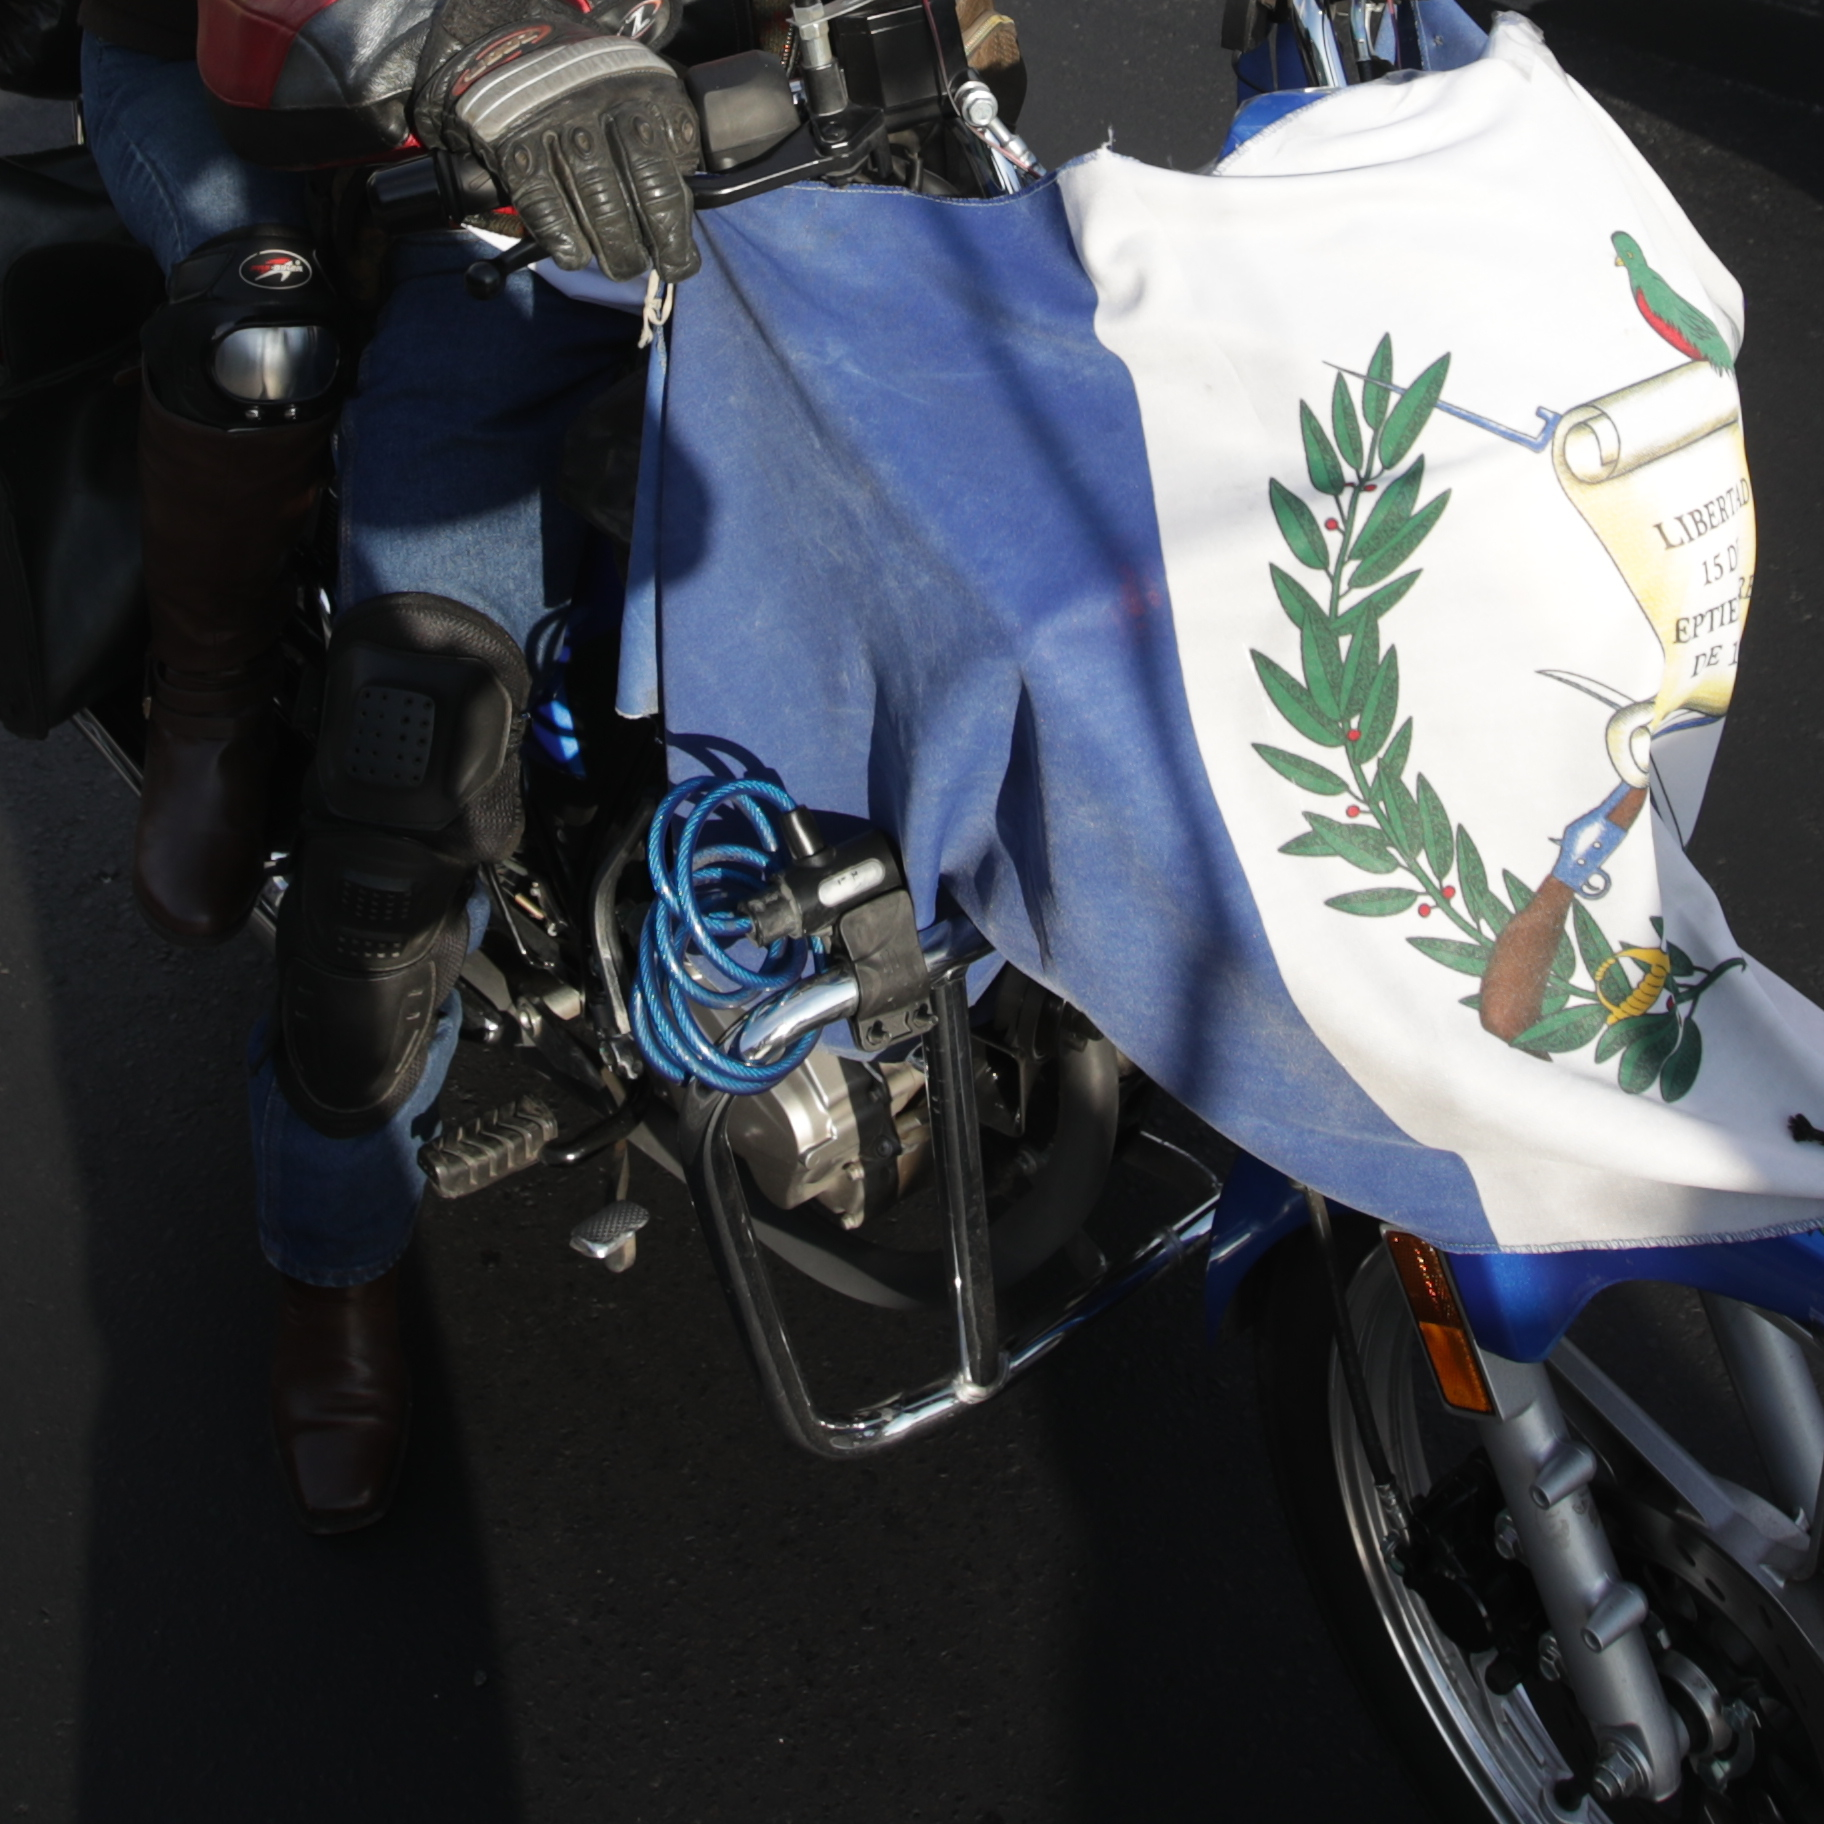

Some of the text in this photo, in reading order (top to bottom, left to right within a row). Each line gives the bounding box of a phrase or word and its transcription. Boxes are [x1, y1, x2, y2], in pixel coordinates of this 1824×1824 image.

[1653, 477, 1750, 550] LIBERTAD
[1702, 553, 1725, 586] 15
[1691, 645, 1723, 678] DE
